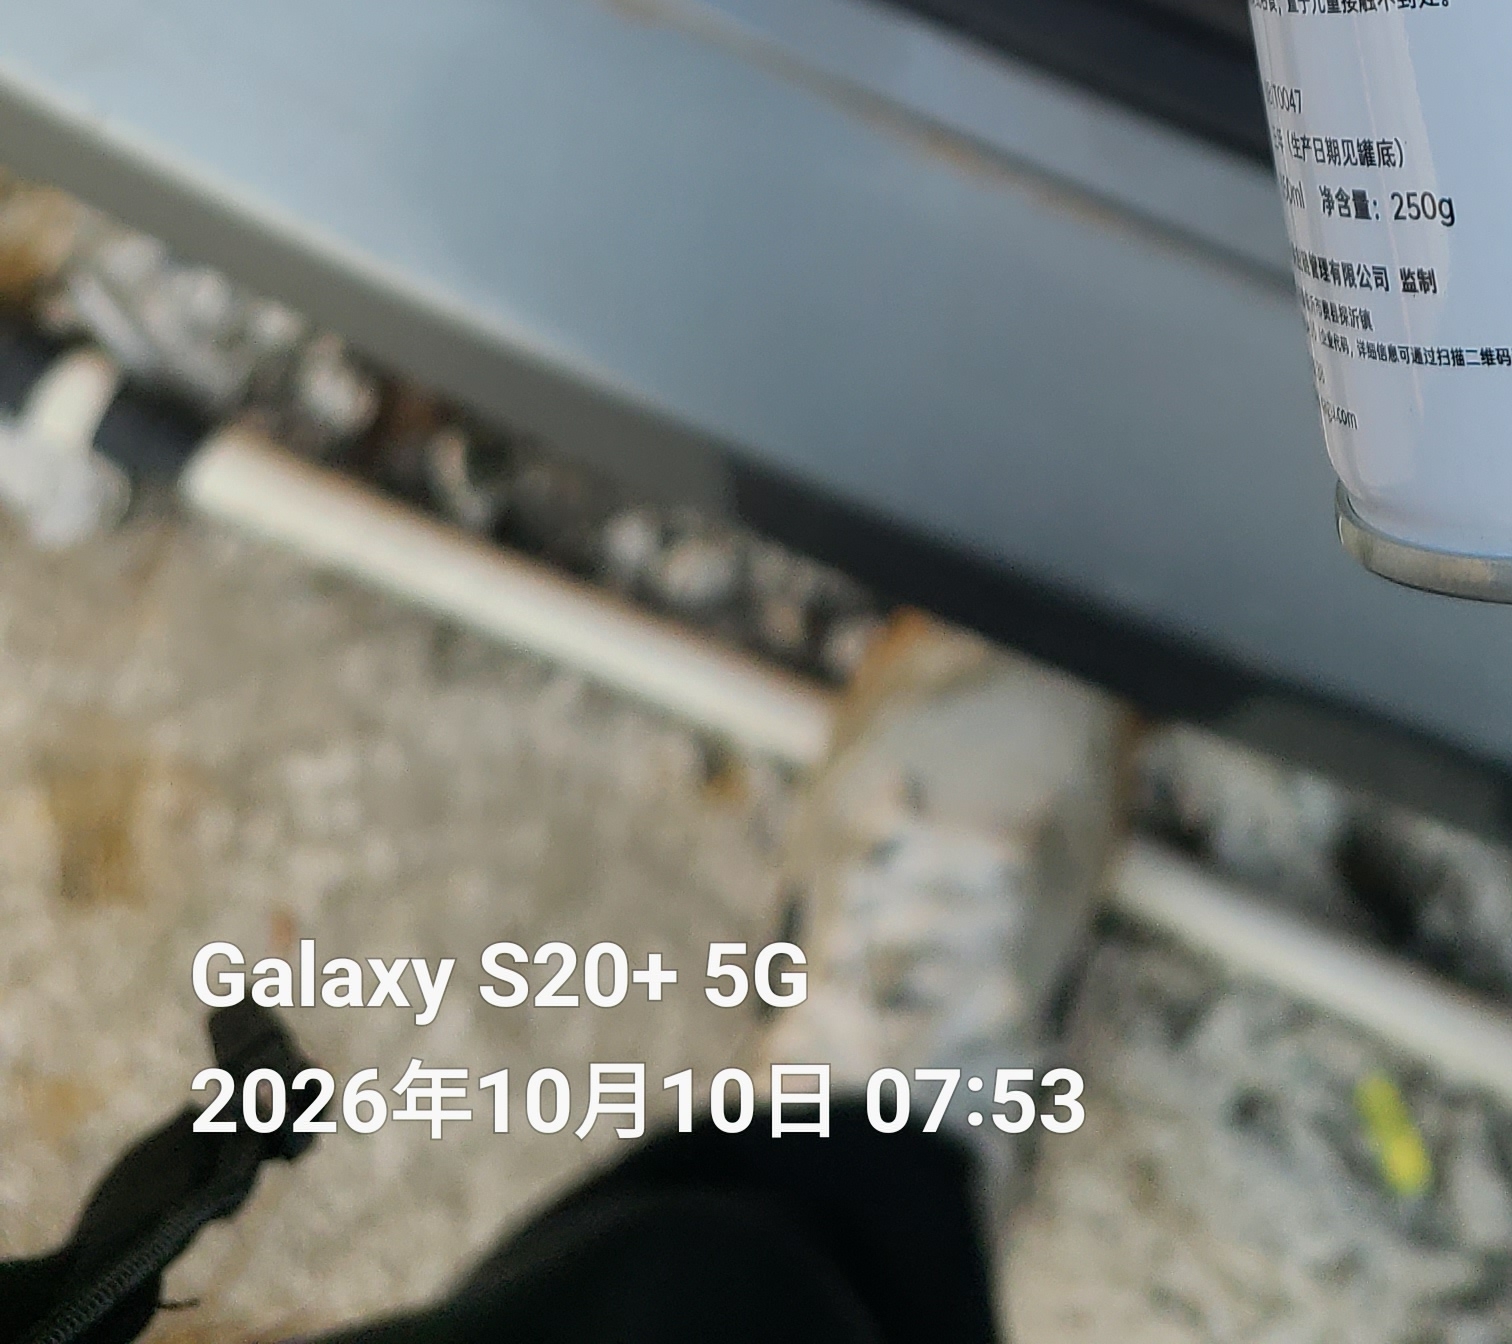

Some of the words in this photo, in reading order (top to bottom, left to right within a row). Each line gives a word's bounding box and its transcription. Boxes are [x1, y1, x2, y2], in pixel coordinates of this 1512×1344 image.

[1319, 184, 1456, 227] 净含量：250g
[1399, 266, 1438, 294] 监制
